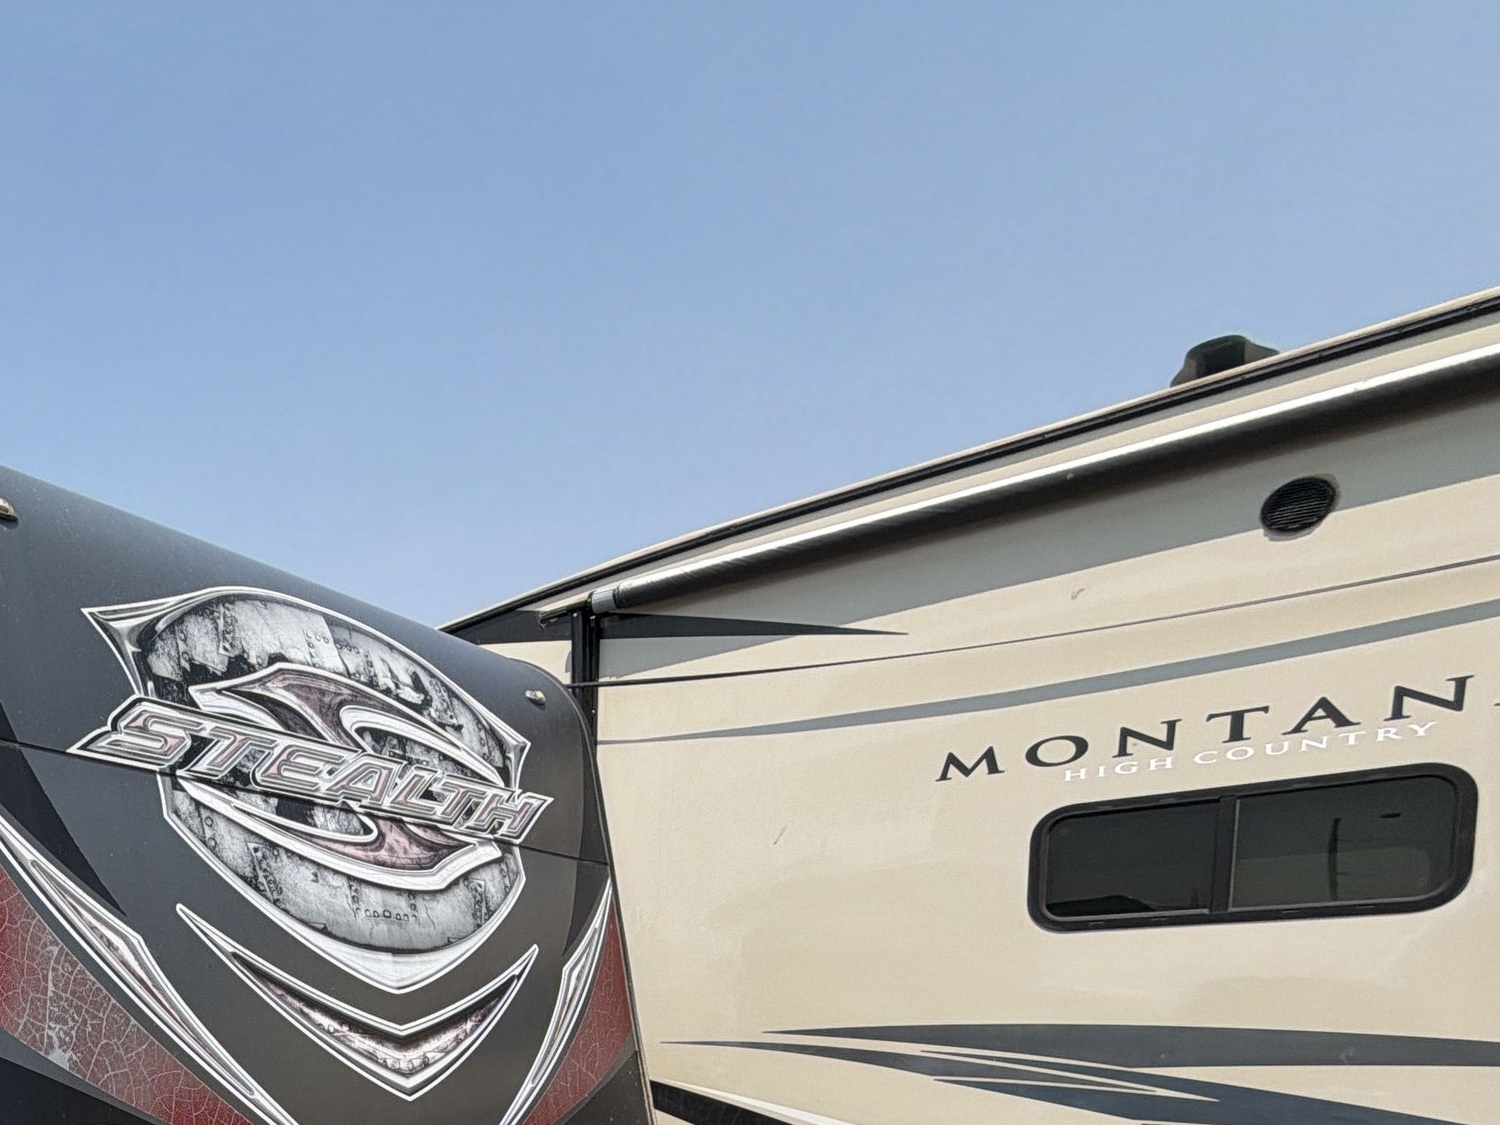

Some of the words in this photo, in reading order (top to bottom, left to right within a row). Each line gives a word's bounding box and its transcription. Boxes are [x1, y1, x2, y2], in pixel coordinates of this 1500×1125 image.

[72, 698, 550, 844] STEALTH
[935, 674, 1500, 782] MONTAN
[1064, 755, 1175, 782] HIGH
[1193, 721, 1438, 765] COUNTRY
